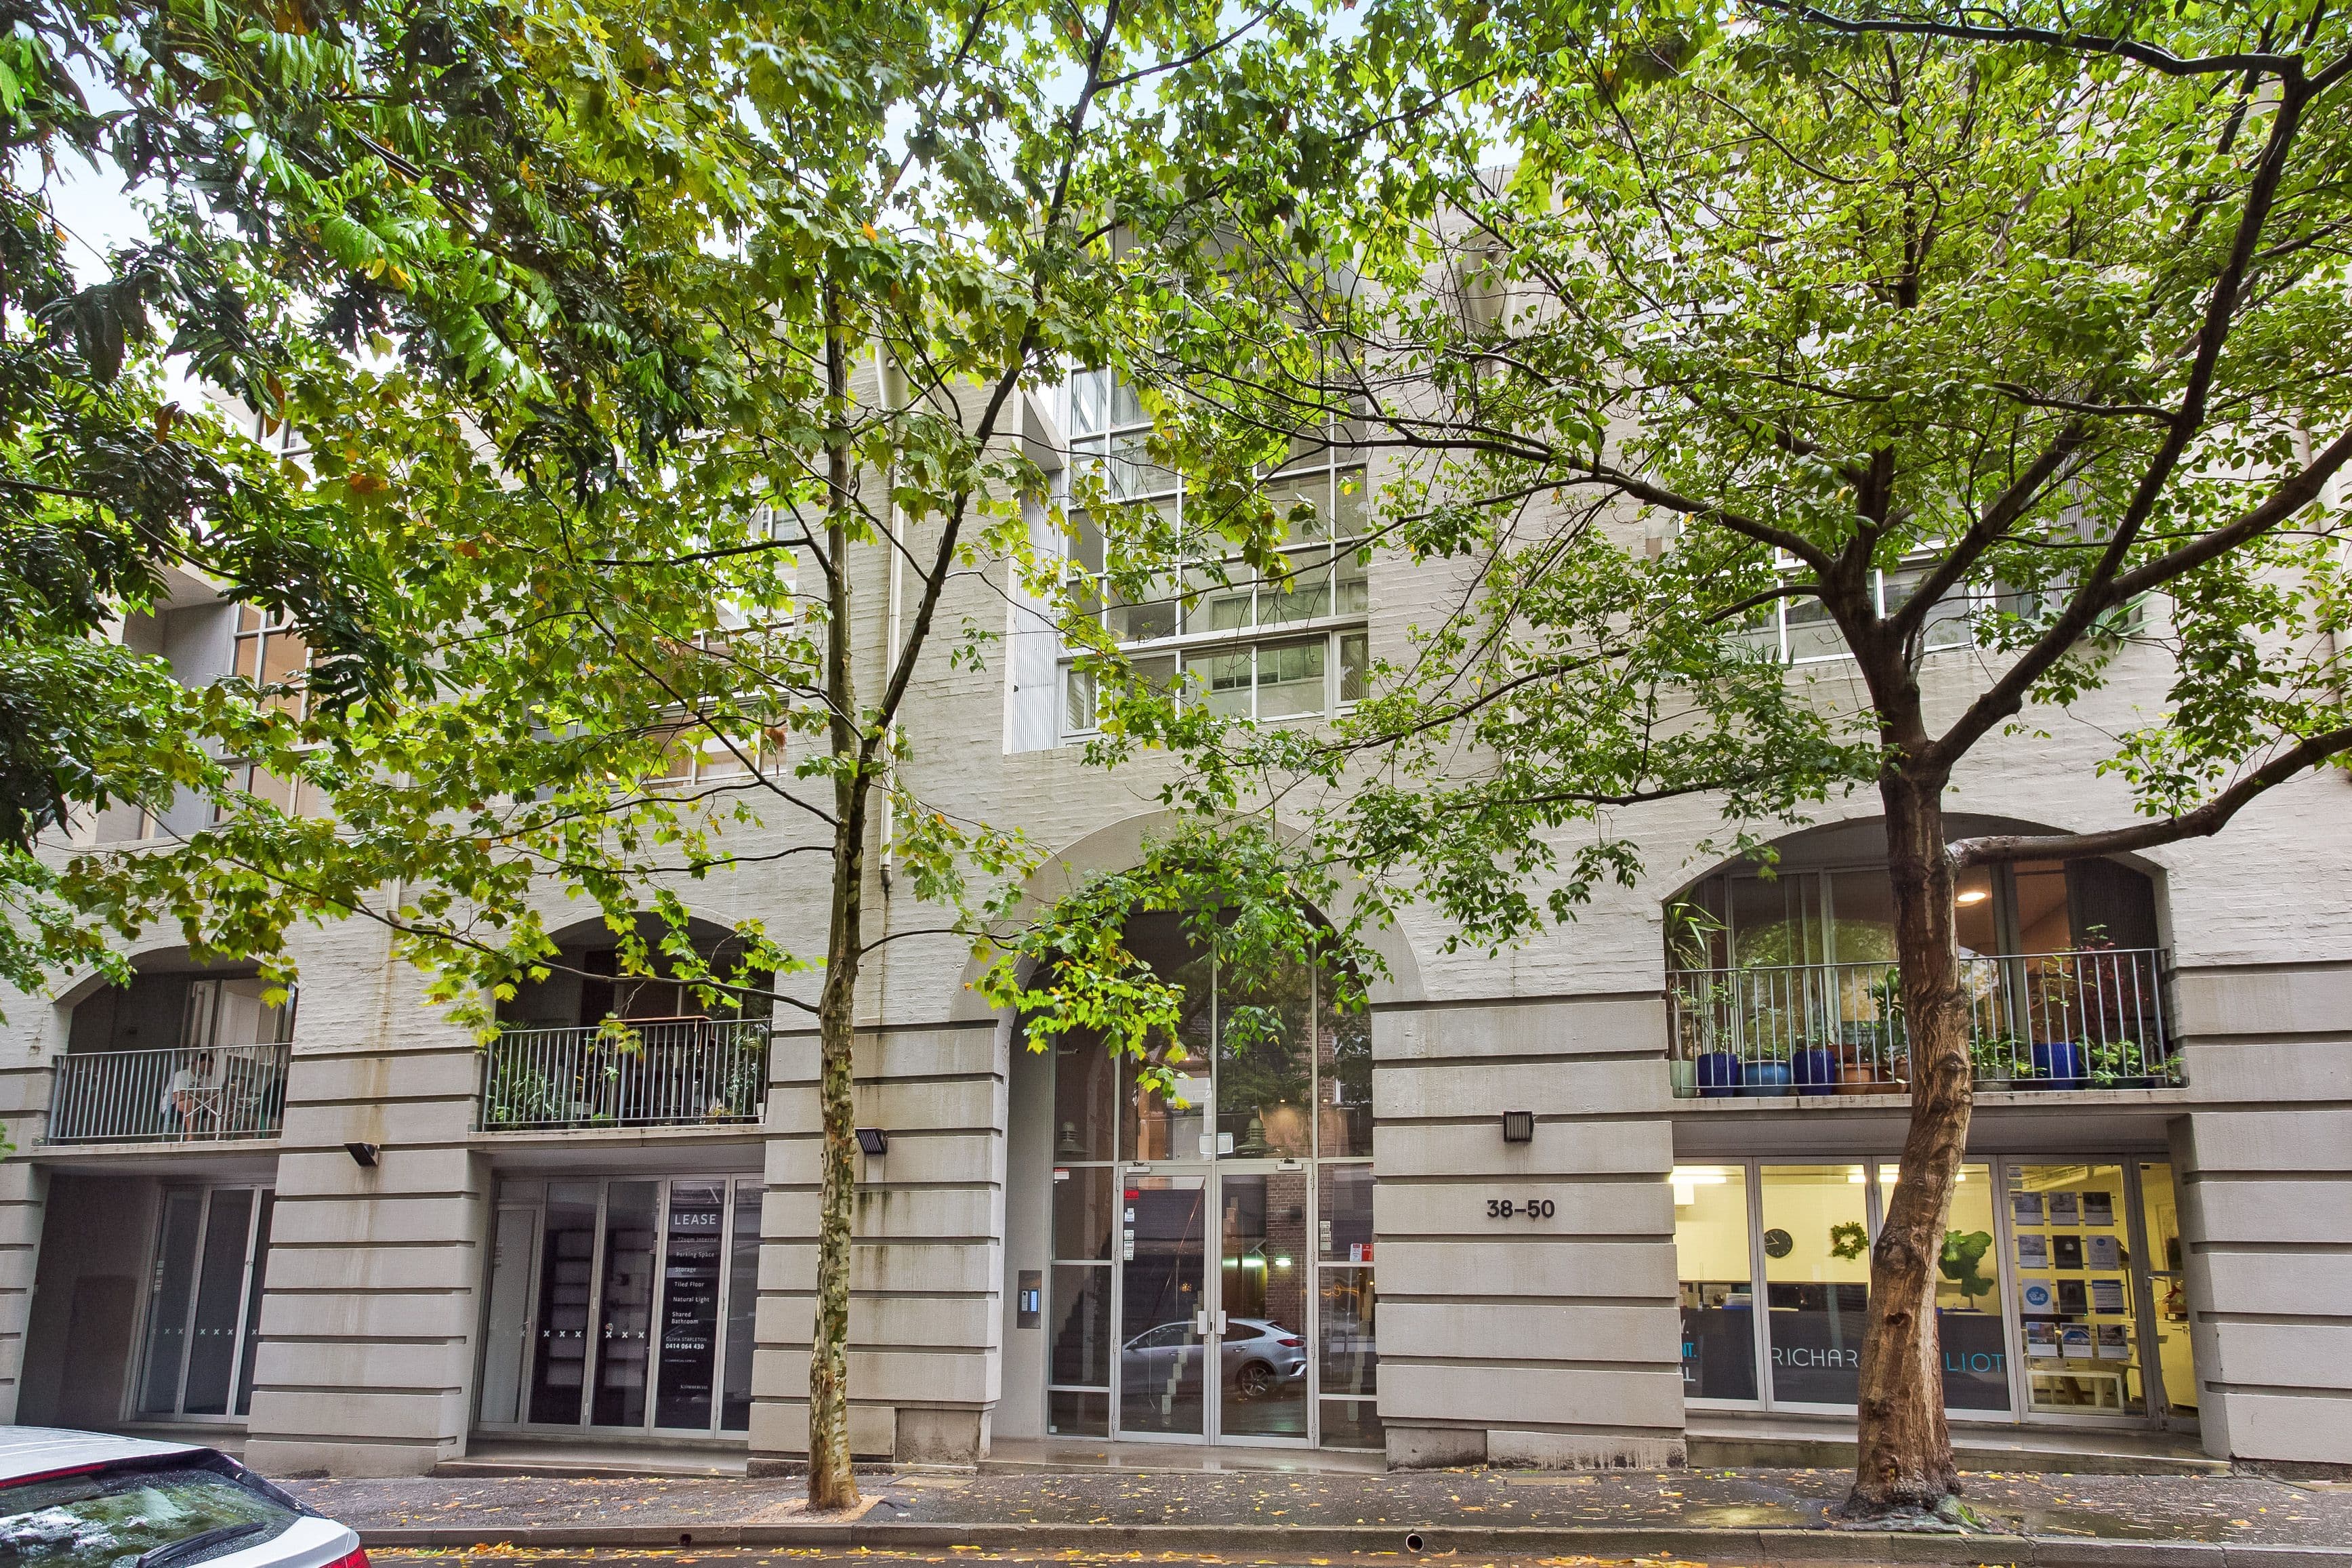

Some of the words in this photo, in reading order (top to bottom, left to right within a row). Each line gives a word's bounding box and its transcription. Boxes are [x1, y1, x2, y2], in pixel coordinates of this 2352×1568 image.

[1487, 1199, 1556, 1218] 38-50
[674, 1214, 717, 1225] LEASE
[695, 1296, 710, 1304] Light
